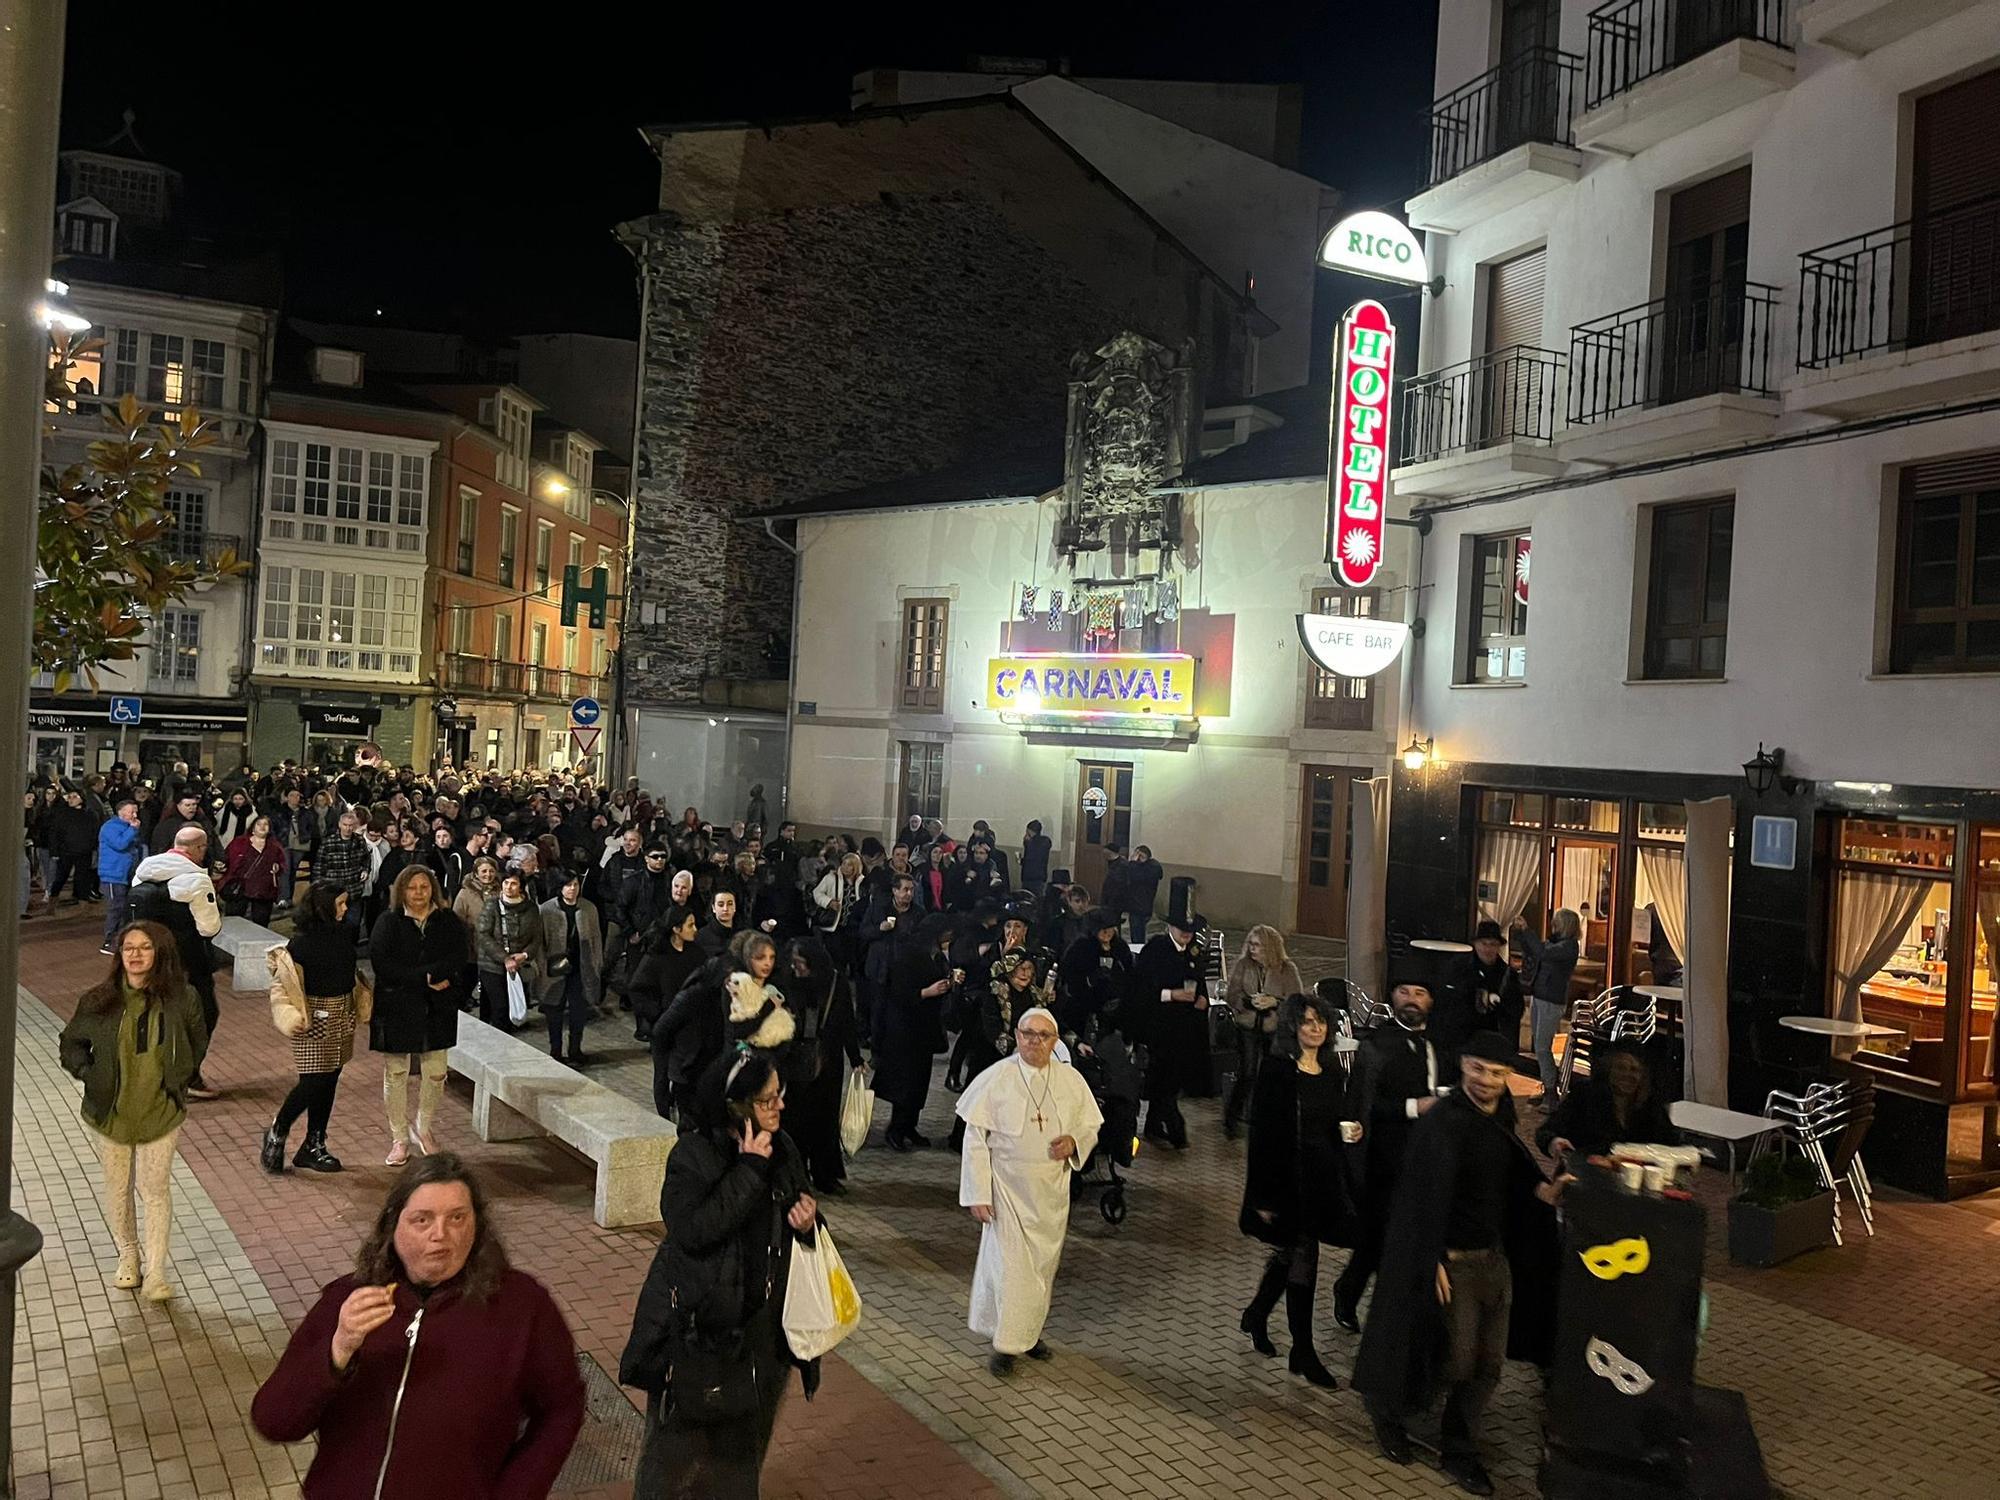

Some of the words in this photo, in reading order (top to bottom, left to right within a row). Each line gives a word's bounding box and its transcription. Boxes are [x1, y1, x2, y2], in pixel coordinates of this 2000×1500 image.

[1347, 229, 1412, 264] RICO
[1345, 327, 1392, 521] HOTEL
[1318, 630, 1354, 647] CAFE
[1364, 634, 1393, 649] BAR
[995, 667, 1184, 703] CARNAVAL
